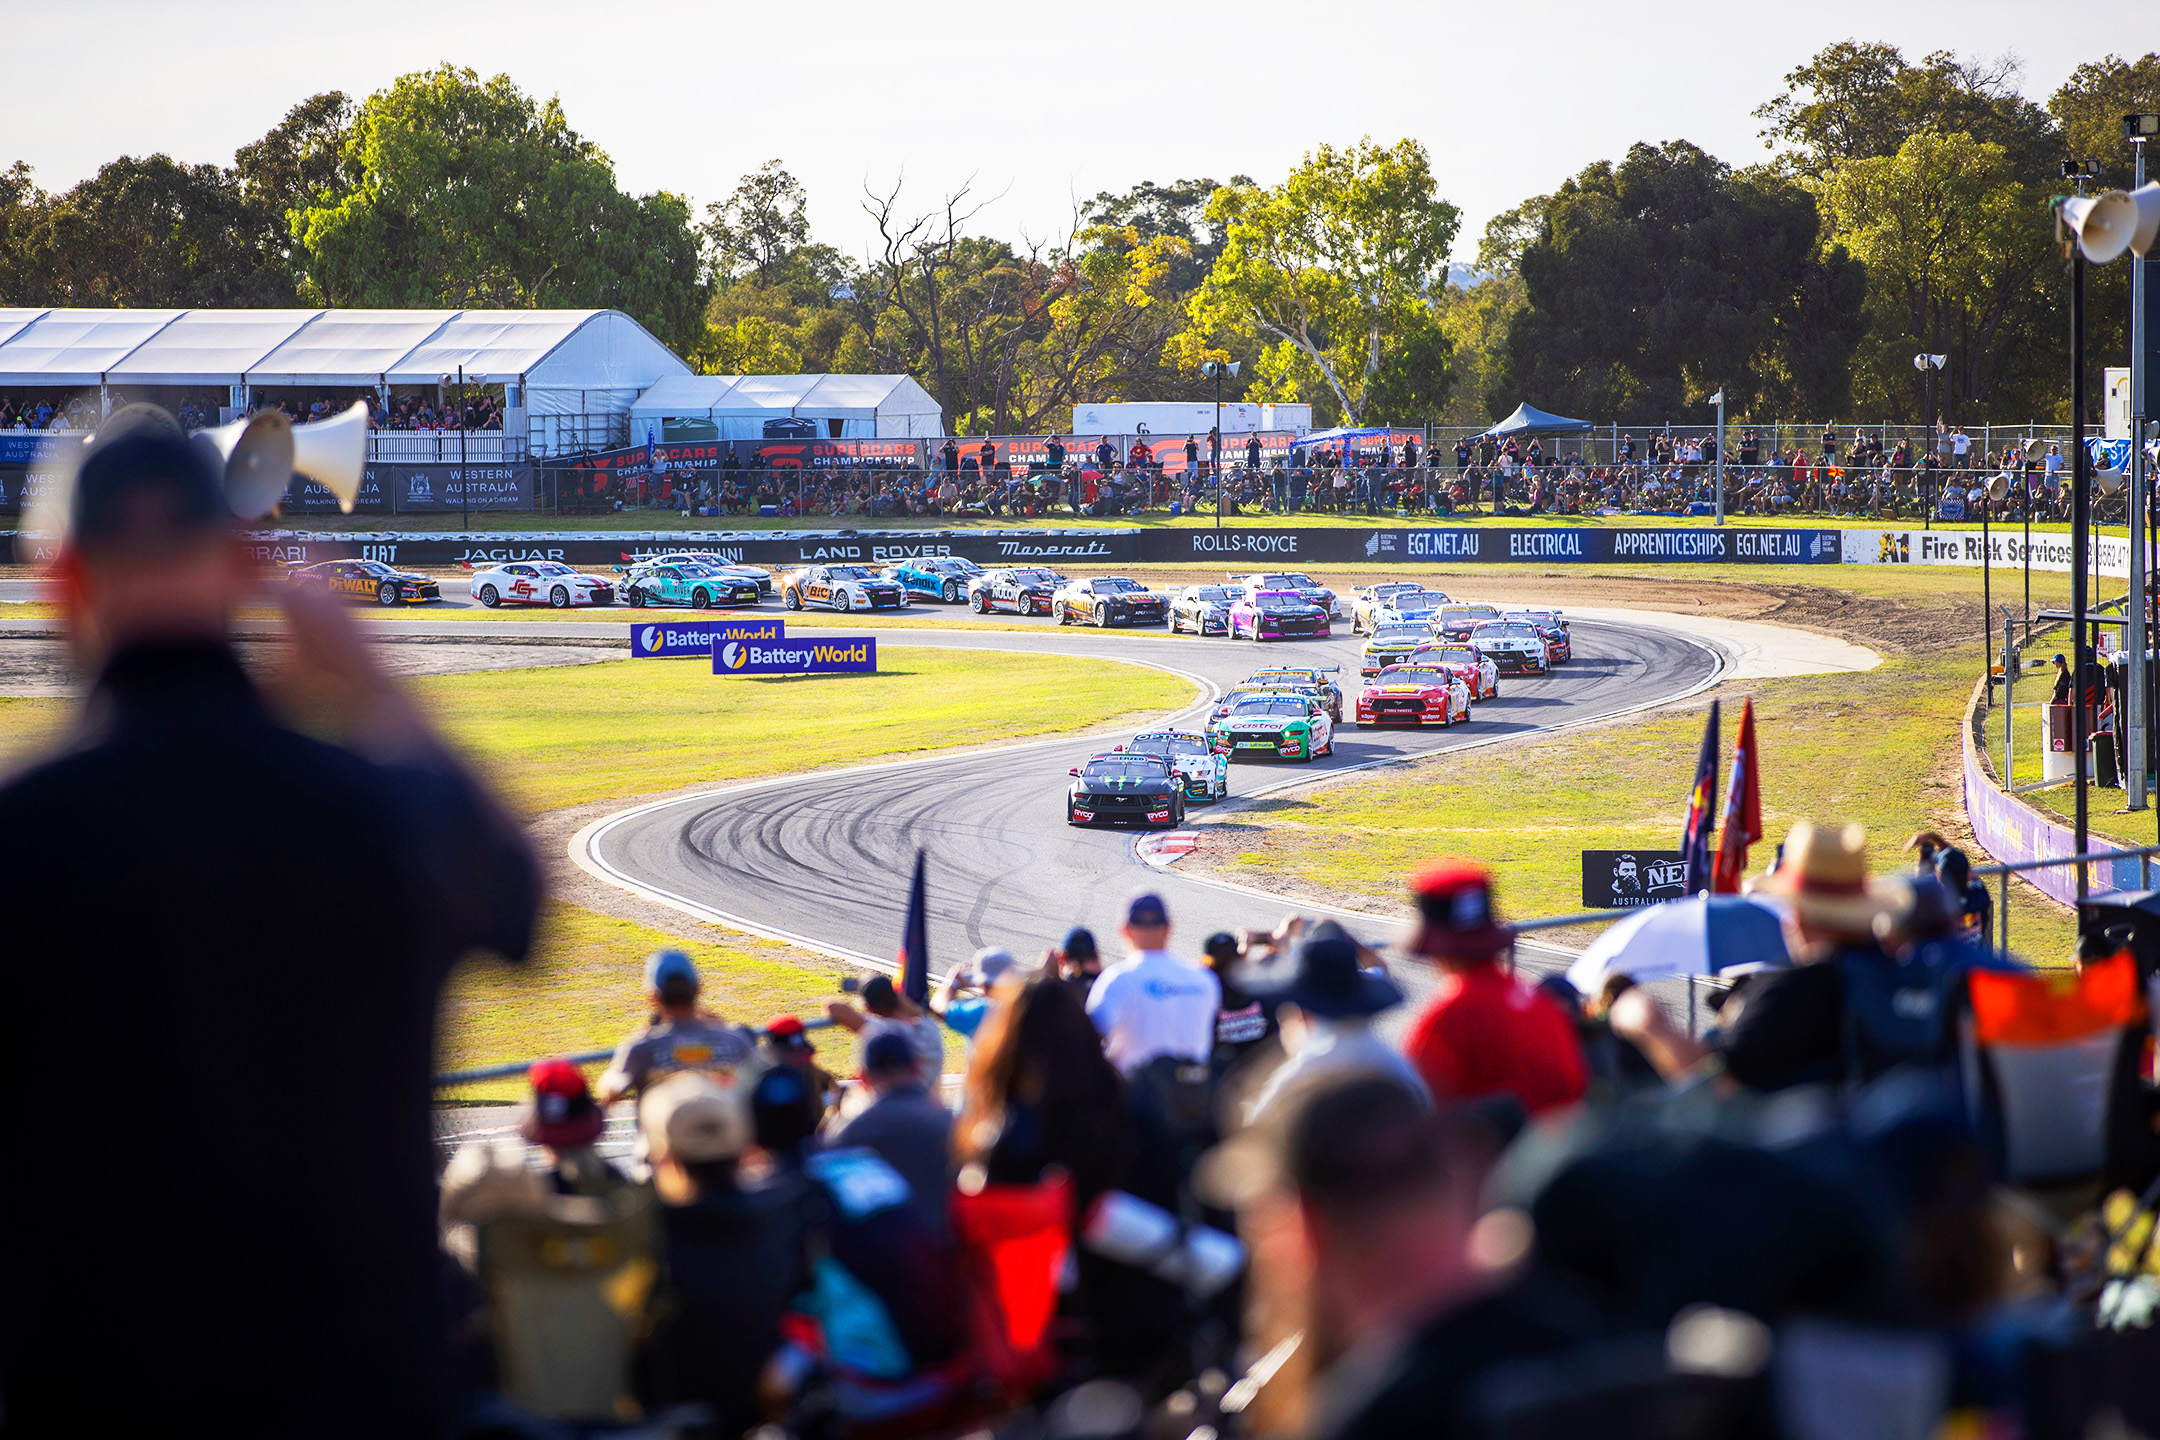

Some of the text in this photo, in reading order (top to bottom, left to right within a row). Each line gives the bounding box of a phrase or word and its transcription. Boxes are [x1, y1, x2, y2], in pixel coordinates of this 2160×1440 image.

[8, 441, 55, 449] WESTERN
[813, 443, 915, 456] SUPERCARS
[616, 447, 718, 467] SUPCARS
[450, 469, 513, 480] WESTERN
[445, 482, 518, 493] AUSTRALIA
[997, 541, 1112, 556] Maserati
[1193, 534, 1298, 552] ROLLS-ROYCE
[1407, 533, 1479, 556] EGT.NET.AU
[1510, 533, 1582, 556] ELECTRICAL
[1614, 533, 1726, 556] APPRENTICESHIPS
[1736, 533, 1800, 556] EGT.NET.AU
[1921, 536, 1959, 560] Fire
[1965, 537, 2003, 562] Risk
[2007, 538, 2072, 564] Services
[363, 545, 398, 562] FIAT
[454, 548, 566, 561] JAGUAR
[800, 545, 951, 560] LAND ROVER
[902, 571, 936, 590] Bendix
[1232, 722, 1283, 730] Castrol
[1280, 745, 1301, 754] RYCO
[1074, 809, 1094, 819] RYCO
[1148, 810, 1169, 820] RYCO
[1612, 897, 1667, 906] AUSTRALIAN
